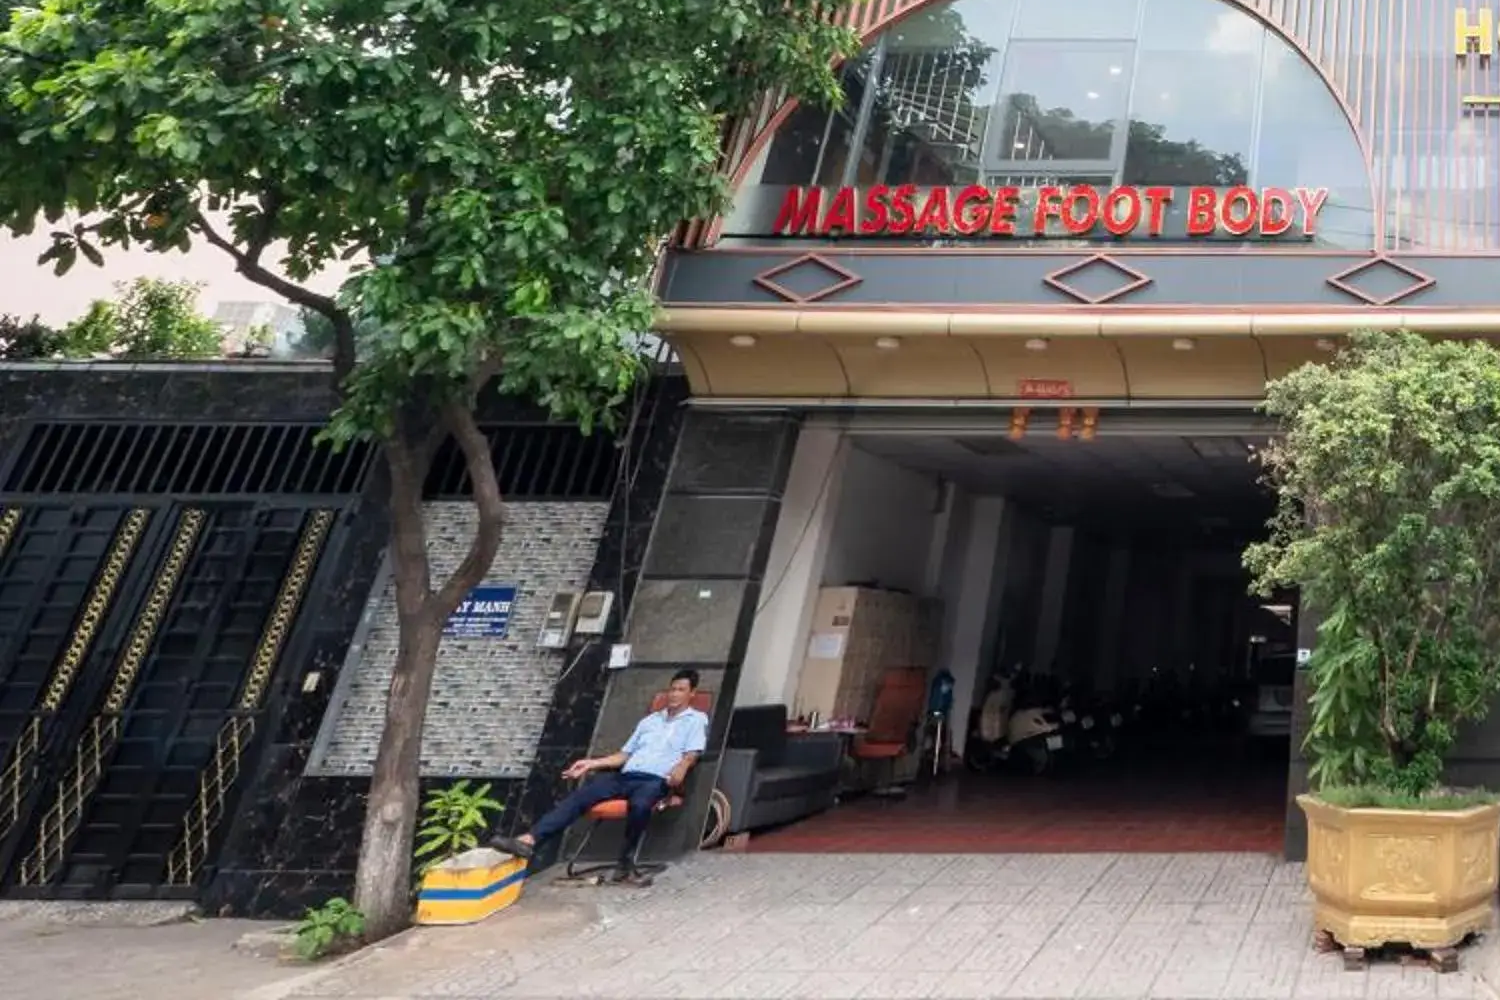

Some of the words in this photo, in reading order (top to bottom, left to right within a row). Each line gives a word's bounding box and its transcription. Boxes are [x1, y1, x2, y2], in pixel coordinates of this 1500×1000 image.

[773, 184, 1021, 235] MASSAGE
[1034, 184, 1174, 235] FOOT
[1185, 184, 1330, 236] BODY
